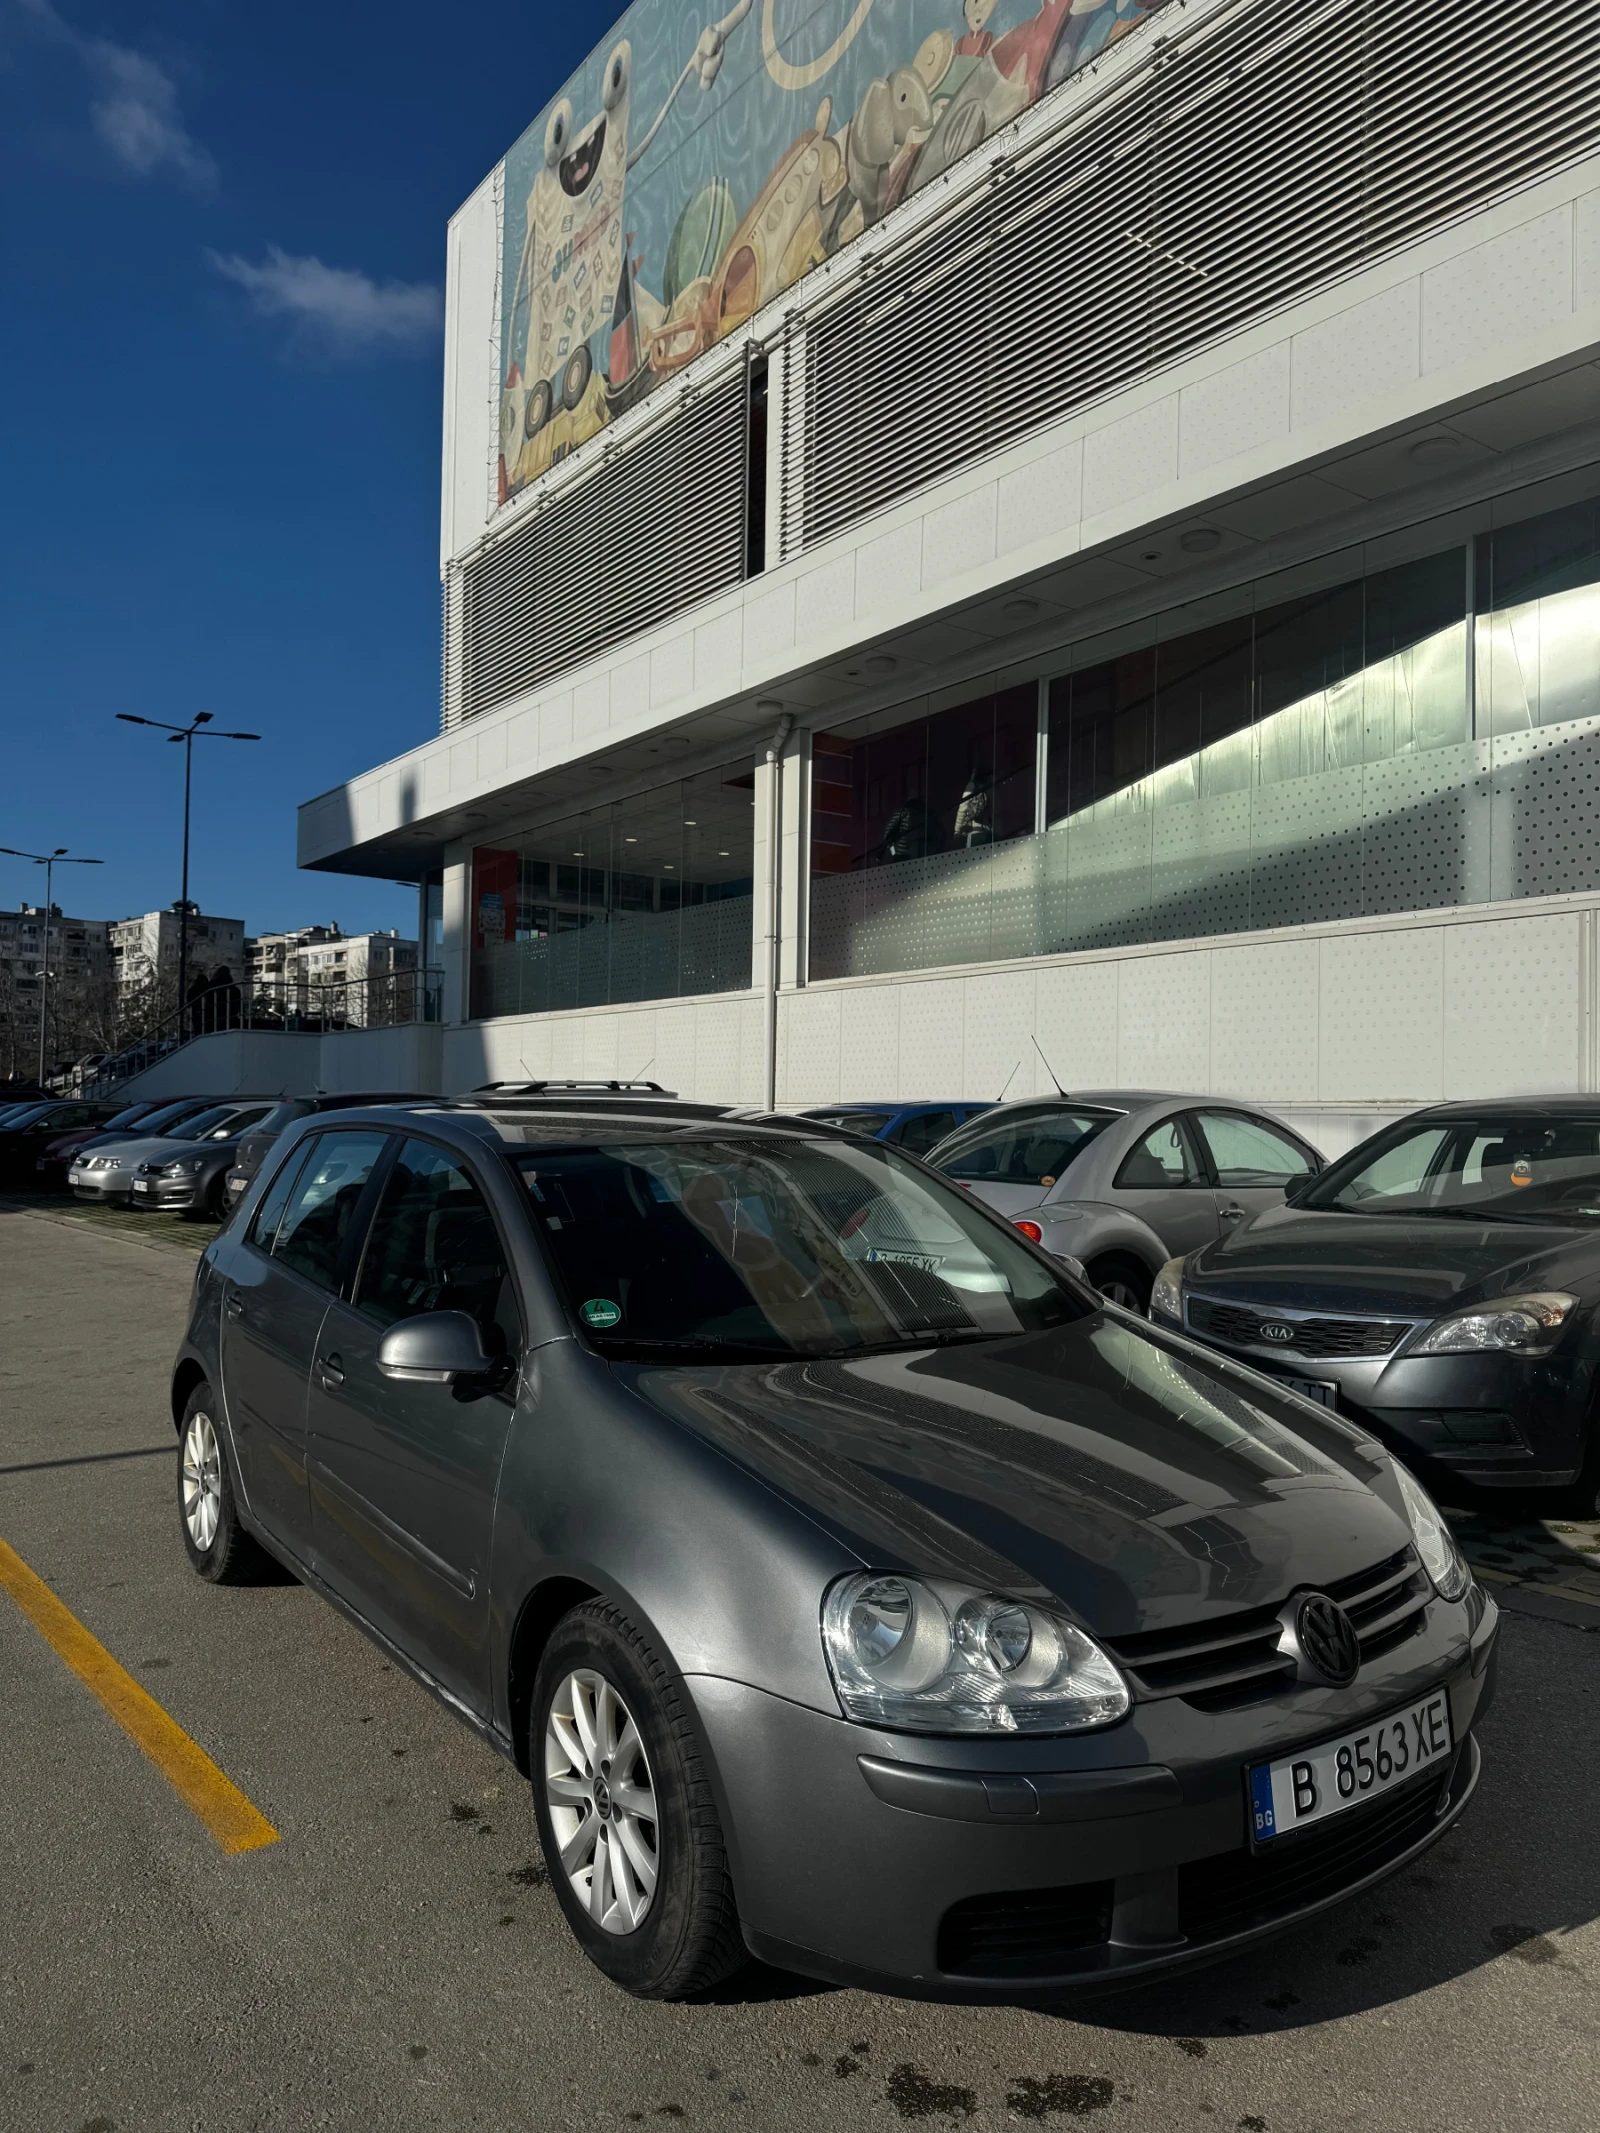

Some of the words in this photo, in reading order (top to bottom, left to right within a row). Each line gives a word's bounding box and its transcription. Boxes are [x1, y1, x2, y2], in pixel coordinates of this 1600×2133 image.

[594, 1301, 605, 1313] 4
[1266, 1326, 1287, 1339] KIA
[1291, 1760, 1317, 1818] B
[1336, 1721, 1409, 1798] 8563
[1411, 1698, 1446, 1763] XE
[1255, 1810, 1273, 1830] BG
